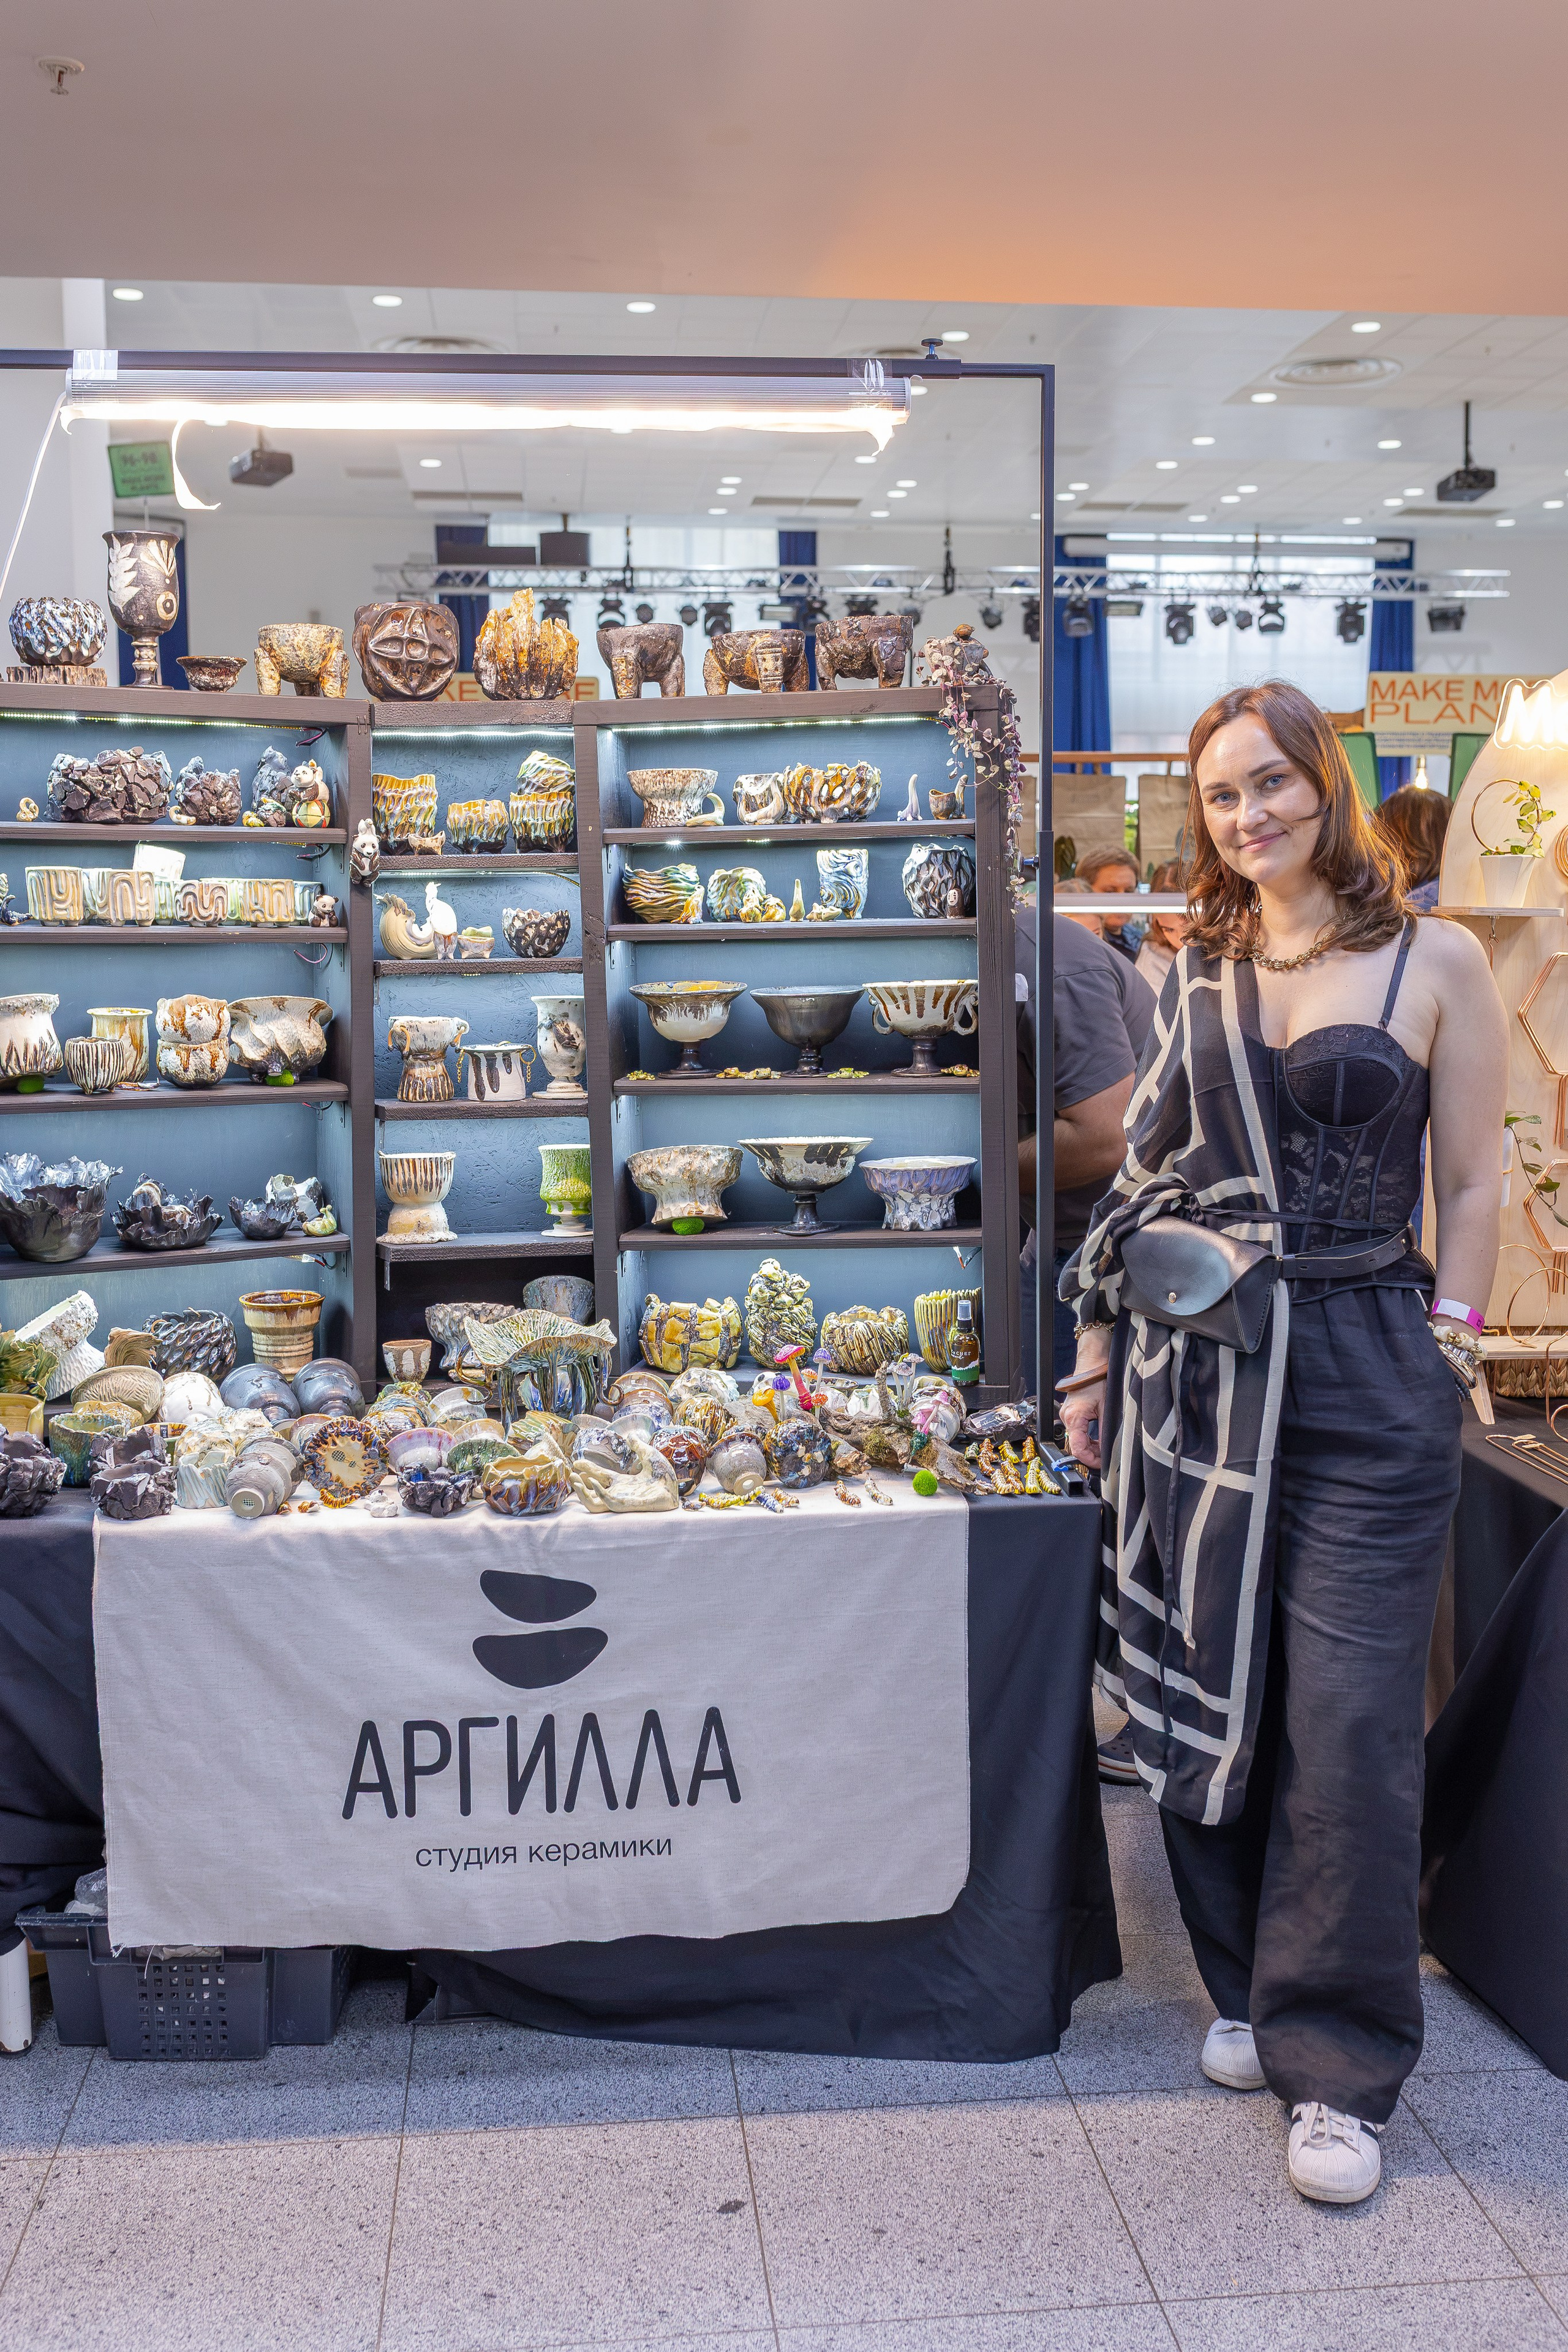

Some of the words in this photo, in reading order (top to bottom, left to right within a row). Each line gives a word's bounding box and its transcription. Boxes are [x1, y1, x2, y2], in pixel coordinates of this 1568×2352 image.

[1370, 679, 1465, 701] MAKE
[342, 1706, 741, 1820] АРГИЛЛА
[416, 1847, 516, 1872] студия
[529, 1839, 671, 1866] керамики
